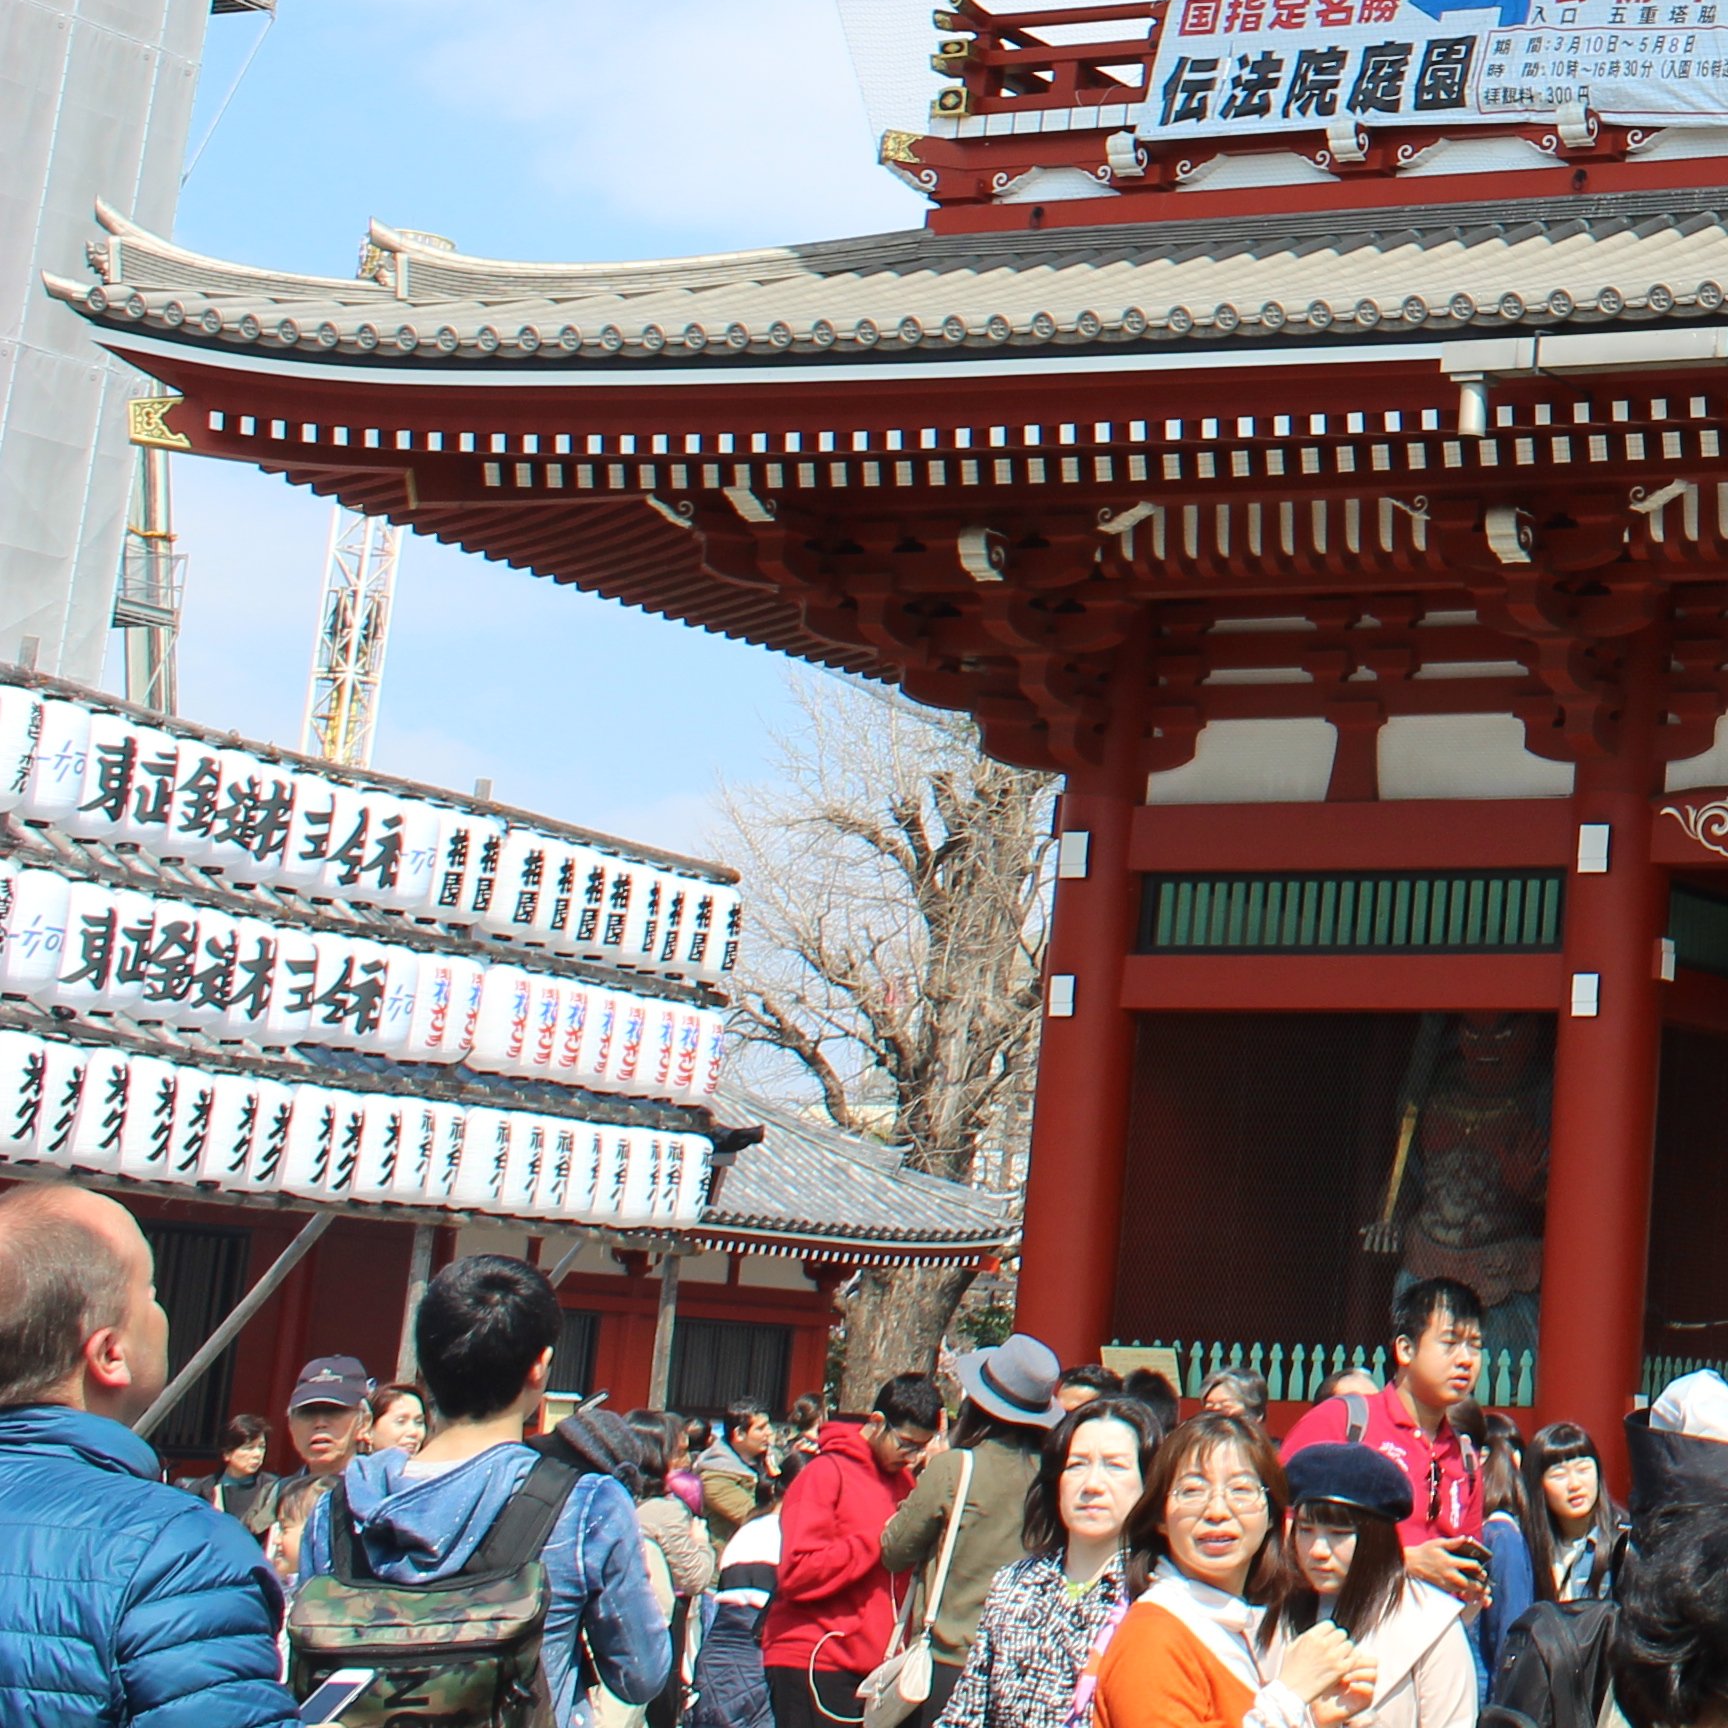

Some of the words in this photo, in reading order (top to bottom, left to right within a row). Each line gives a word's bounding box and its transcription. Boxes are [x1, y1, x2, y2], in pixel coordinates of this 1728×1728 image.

[1531, 7, 1578, 25] 入口
[1608, 5, 1718, 25] 五重塔脇
[1159, 35, 1478, 127] 伝法院庭園
